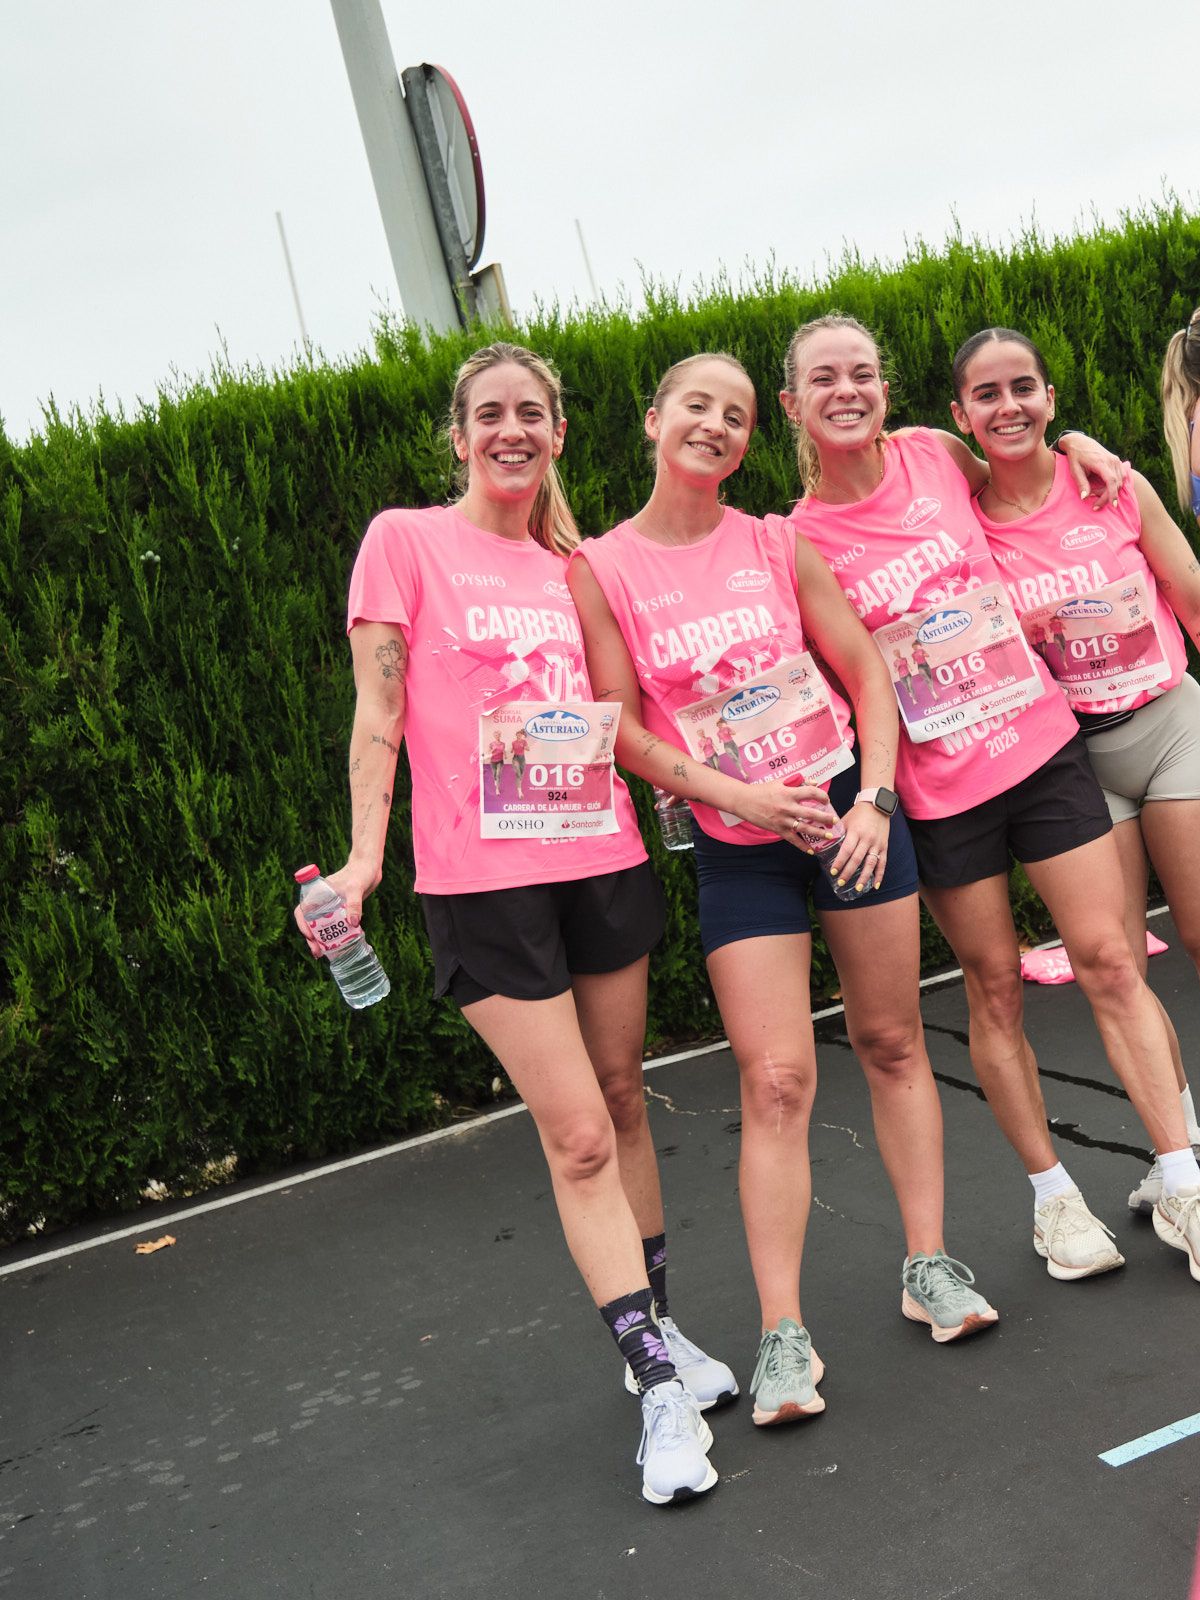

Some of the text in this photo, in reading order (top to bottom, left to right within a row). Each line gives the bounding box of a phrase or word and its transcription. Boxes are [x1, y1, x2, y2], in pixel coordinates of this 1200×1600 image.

[452, 572, 506, 588] OYSHO
[632, 591, 684, 615] OYSHO
[1061, 606, 1109, 617] ASTURIANA
[887, 629, 914, 644] SUMA
[923, 617, 969, 641] ASTURIANA
[1071, 634, 1119, 659] 016
[935, 651, 986, 685] 016
[1090, 659, 1107, 670] 927
[1092, 671, 1101, 679] LA
[1102, 665, 1124, 677] MUJER
[958, 679, 976, 692] 925
[1118, 673, 1155, 690] Santander
[727, 692, 777, 719] ASTURIANA
[923, 700, 953, 716] CARRERA
[953, 695, 964, 704] DE
[963, 691, 974, 701] LA
[972, 685, 993, 698] MUJER
[989, 689, 1028, 709] Santander
[493, 715, 523, 723] SUMA
[691, 707, 718, 724] SUMA
[924, 711, 965, 733] OYSHO
[530, 721, 585, 734] ASTURIANA
[743, 726, 797, 763] 016
[985, 726, 1020, 759] 2026
[768, 755, 788, 770] 926
[775, 769, 784, 778] LA
[784, 759, 807, 774] MUJER
[808, 759, 838, 780] antander
[529, 764, 585, 787] 016
[547, 791, 568, 801] 924
[503, 803, 536, 812] CARRERA
[538, 803, 548, 812] DE
[549, 803, 559, 812] LA
[559, 803, 582, 812] MUJER
[498, 820, 544, 831] OYSHO
[317, 920, 344, 937] ZERO
[320, 926, 348, 943] SODIO
